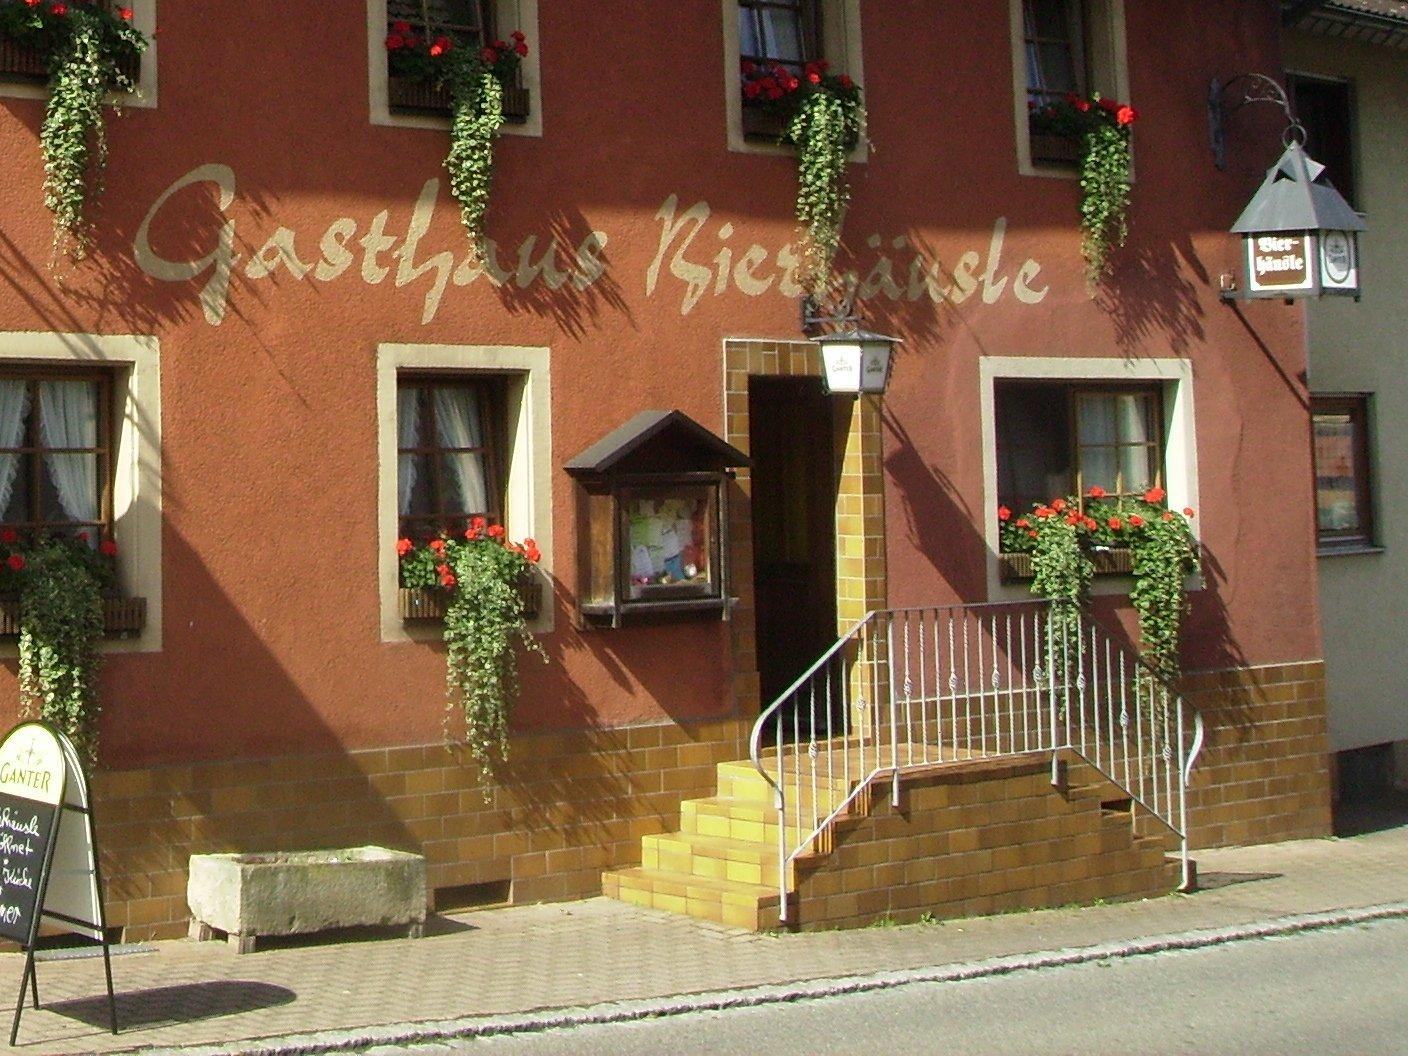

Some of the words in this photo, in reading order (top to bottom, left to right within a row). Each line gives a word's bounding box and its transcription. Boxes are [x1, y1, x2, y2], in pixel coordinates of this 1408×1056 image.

[134, 163, 609, 327] Gasthaus
[645, 193, 1051, 316] Bieräusle
[0, 762, 51, 794] GANTER
